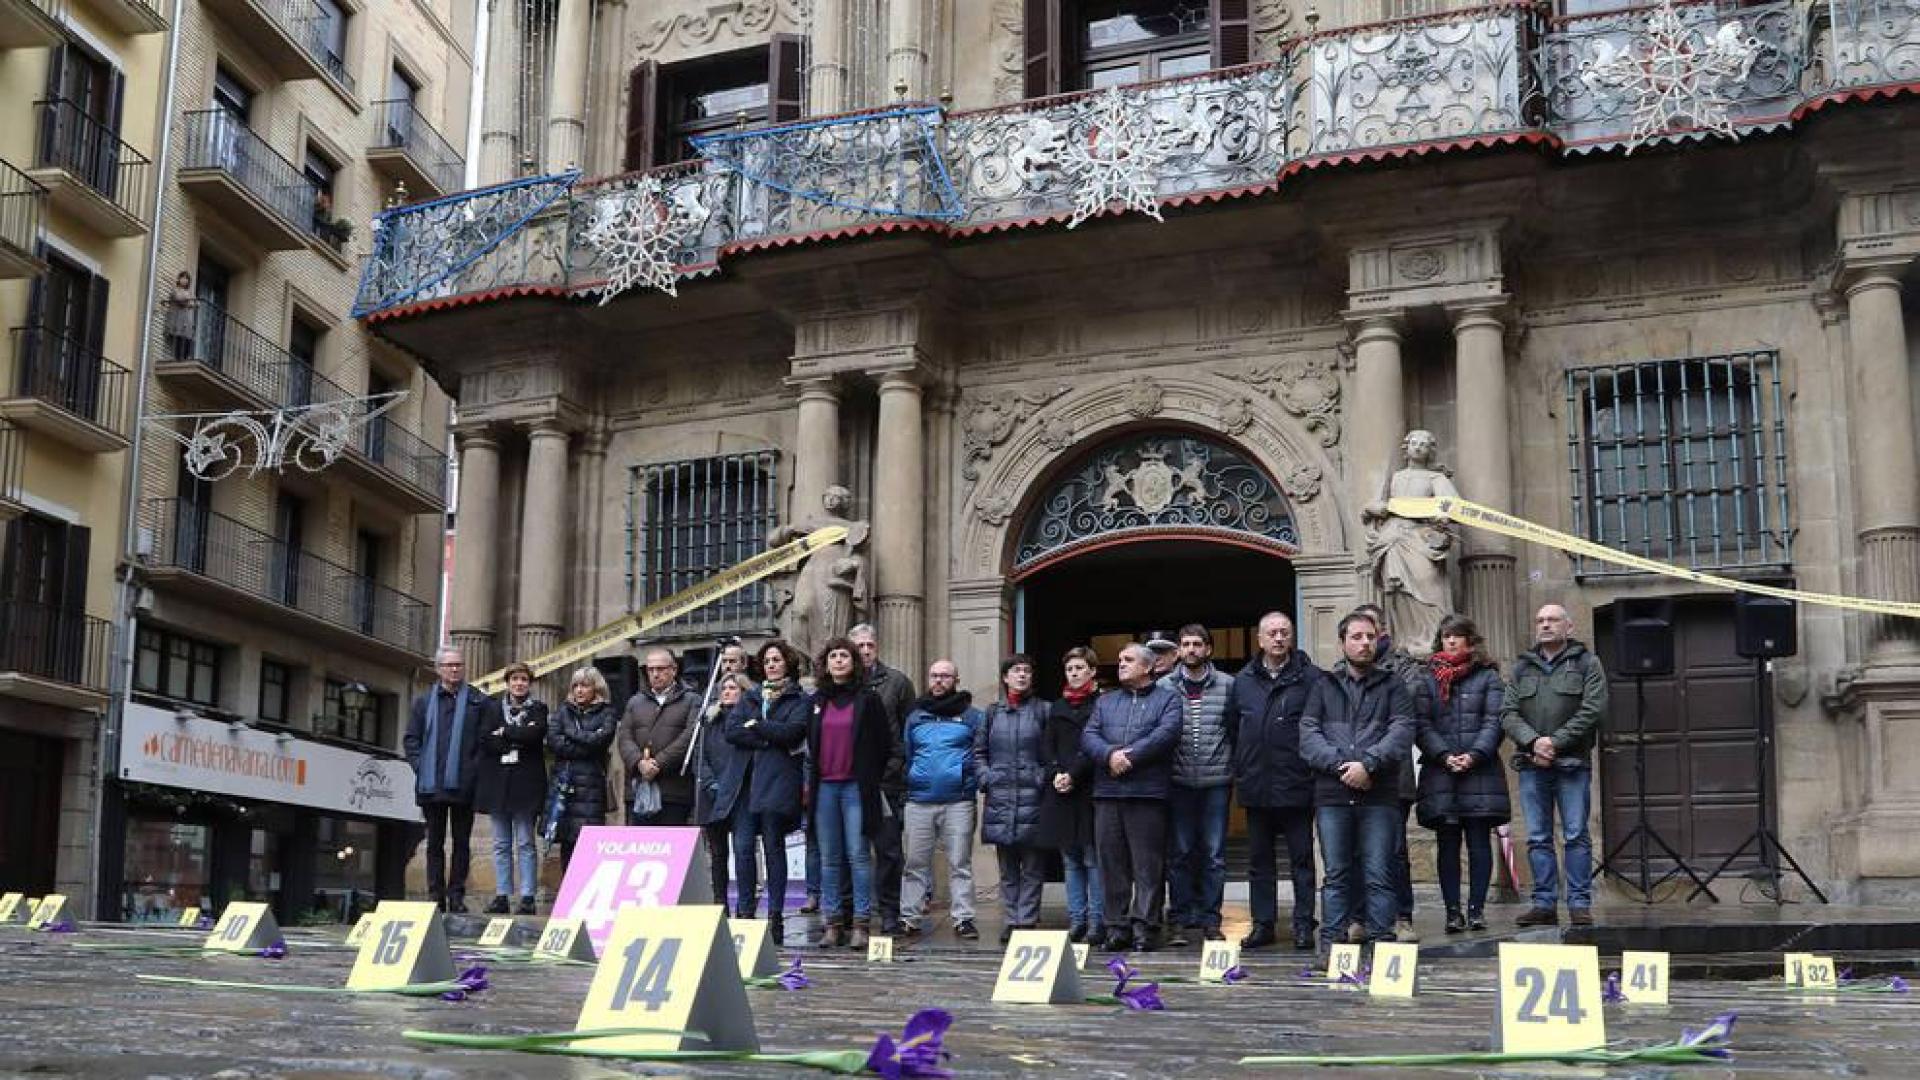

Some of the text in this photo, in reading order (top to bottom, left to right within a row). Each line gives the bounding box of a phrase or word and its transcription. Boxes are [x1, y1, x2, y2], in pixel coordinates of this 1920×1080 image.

[596, 841, 671, 856] YOLANDA
[567, 859, 669, 930] 43
[220, 914, 248, 940] 10
[371, 920, 416, 965] 15
[1008, 945, 1051, 982] 22
[1205, 949, 1230, 970] 40
[1336, 951, 1352, 970] 13
[1385, 955, 1402, 982] 4
[1807, 964, 1828, 982] 32
[609, 937, 683, 1012] 14
[1630, 963, 1658, 991] 41
[1514, 966, 1588, 1025] 24
